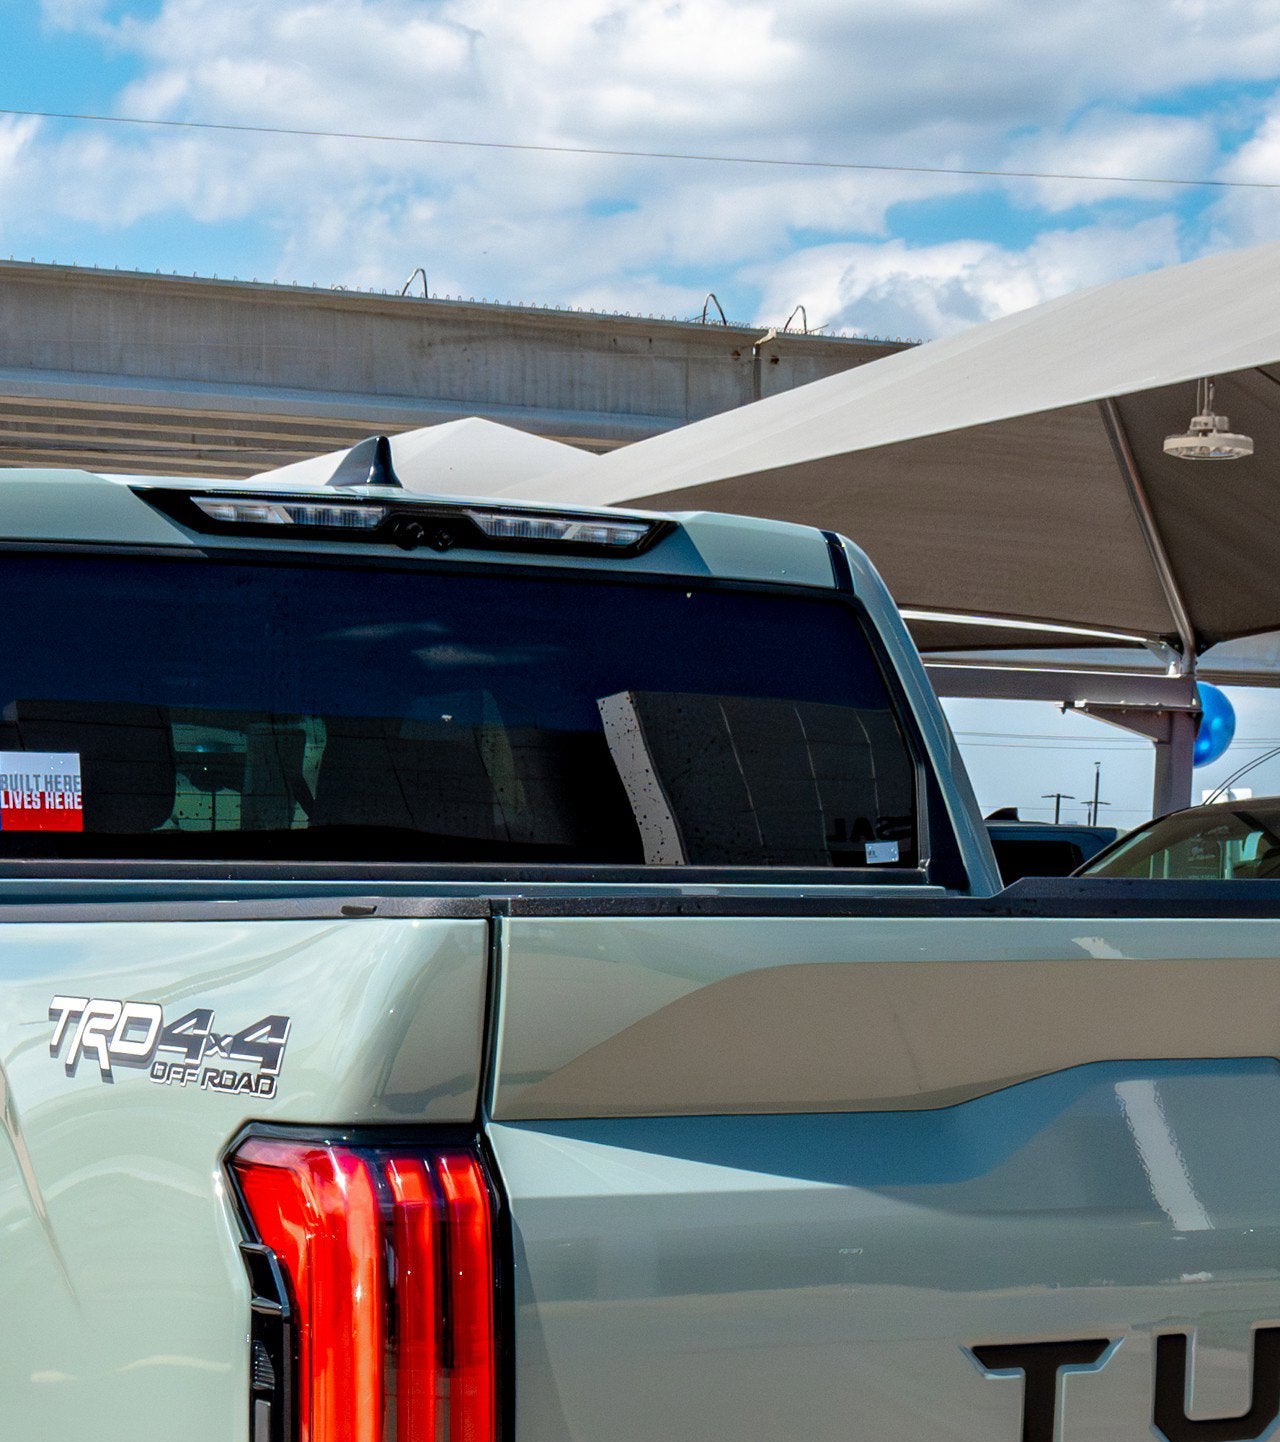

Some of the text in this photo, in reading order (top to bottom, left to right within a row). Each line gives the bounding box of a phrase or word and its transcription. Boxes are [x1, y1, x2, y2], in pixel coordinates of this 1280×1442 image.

[0, 774, 82, 792] BUILT HERE
[0, 791, 83, 810] LIVES HERE
[48, 994, 292, 1084] TRD 4x4
[149, 1061, 278, 1100] OFF ROAD
